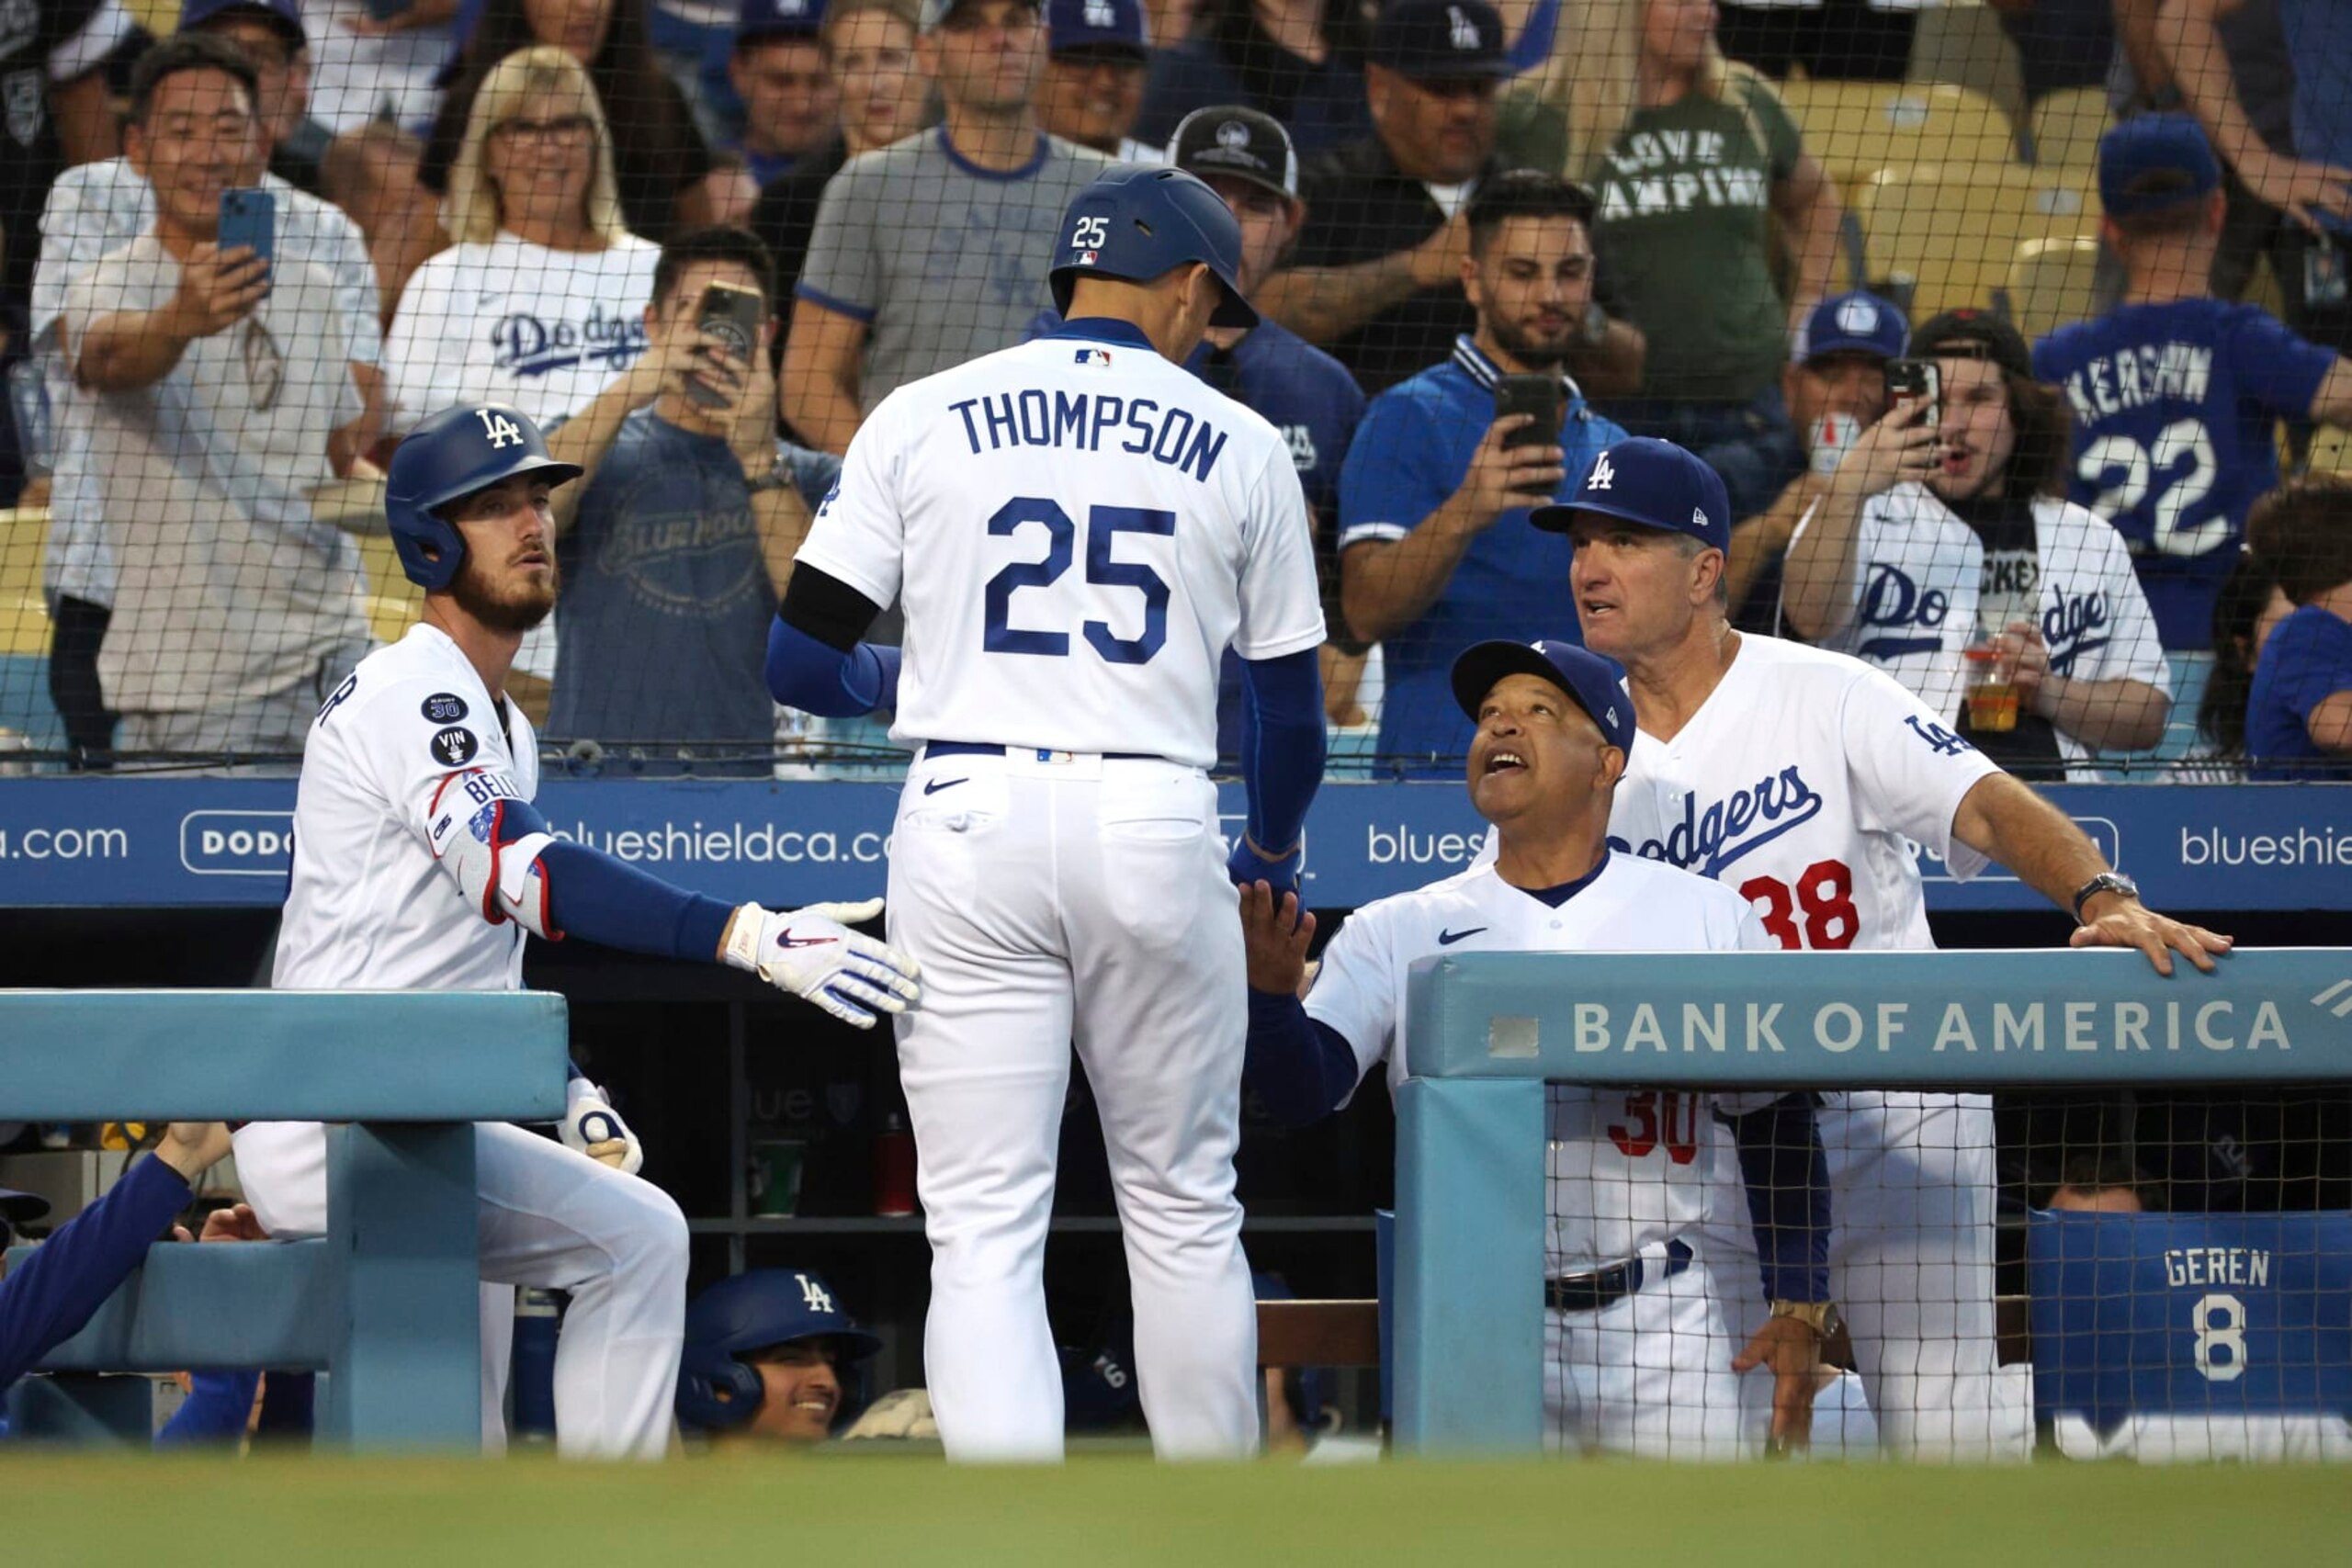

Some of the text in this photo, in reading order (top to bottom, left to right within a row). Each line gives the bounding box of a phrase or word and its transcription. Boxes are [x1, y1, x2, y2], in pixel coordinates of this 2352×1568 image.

[1580, 167, 1769, 222] AMPIN
[1071, 216, 1110, 250] 25
[476, 410, 525, 448] LA
[948, 389, 1228, 483] THOMPSON
[1588, 451, 1615, 490] LA
[2077, 420, 2229, 555] 22
[983, 496, 1177, 665] 25
[439, 731, 467, 748] VIN
[202, 829, 292, 855] DOD
[1606, 765, 1823, 880] odgers
[1738, 859, 1860, 950] 38
[1574, 1000, 2291, 1053] BANK OF AMERICA
[795, 1273, 834, 1313] LA
[2165, 1247, 2269, 1287] GEREN
[2193, 1294, 2247, 1381] 8
